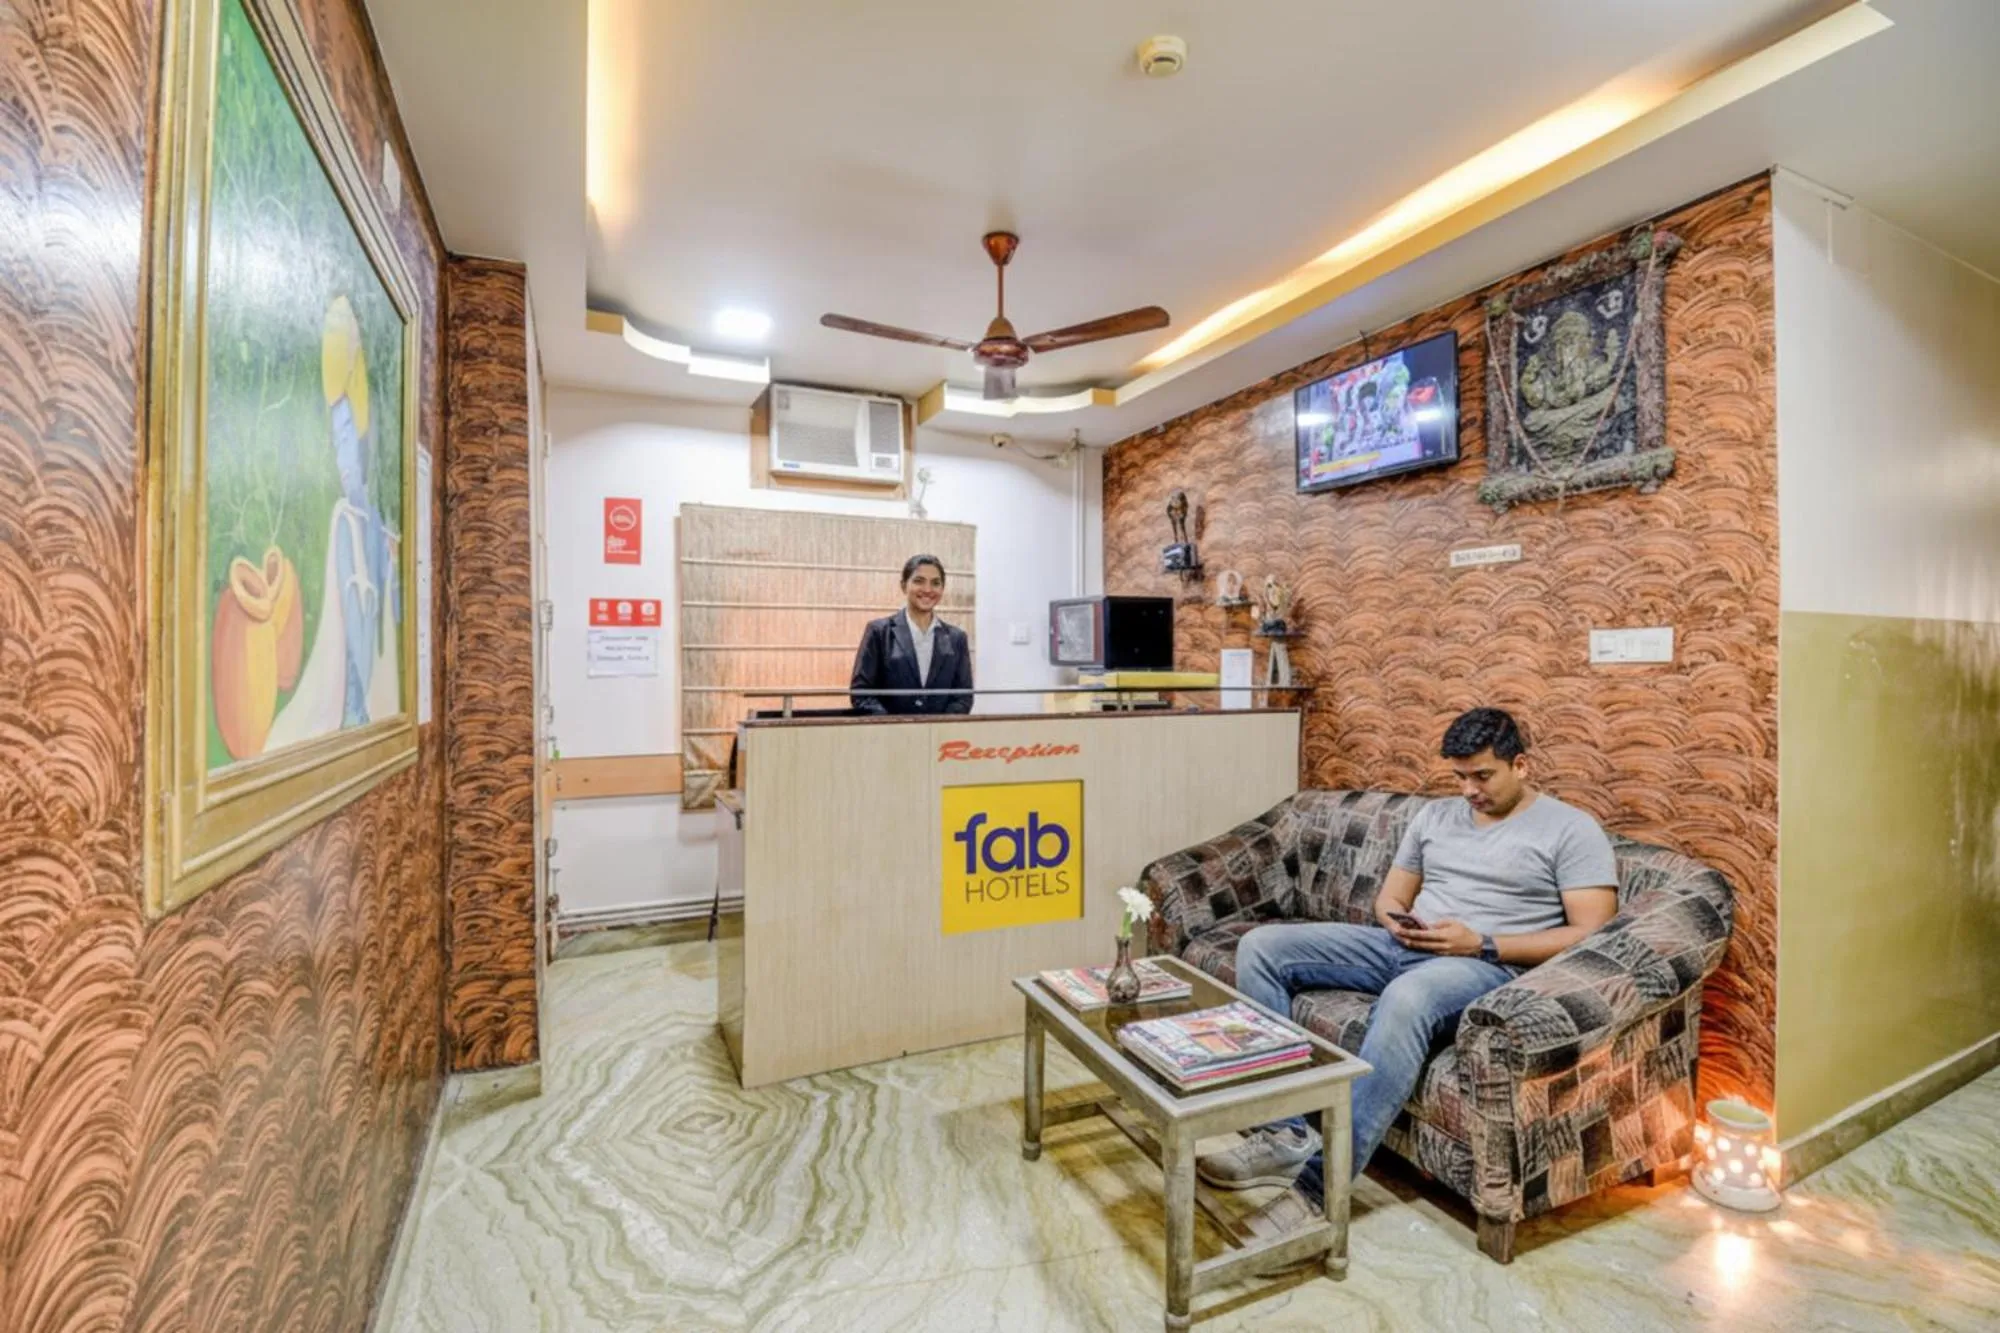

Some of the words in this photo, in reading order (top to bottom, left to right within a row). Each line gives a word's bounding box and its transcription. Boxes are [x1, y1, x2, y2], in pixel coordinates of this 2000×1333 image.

[938, 740, 1080, 764] Reception
[954, 811, 1070, 875] fab
[965, 870, 1070, 904] HOTELS
